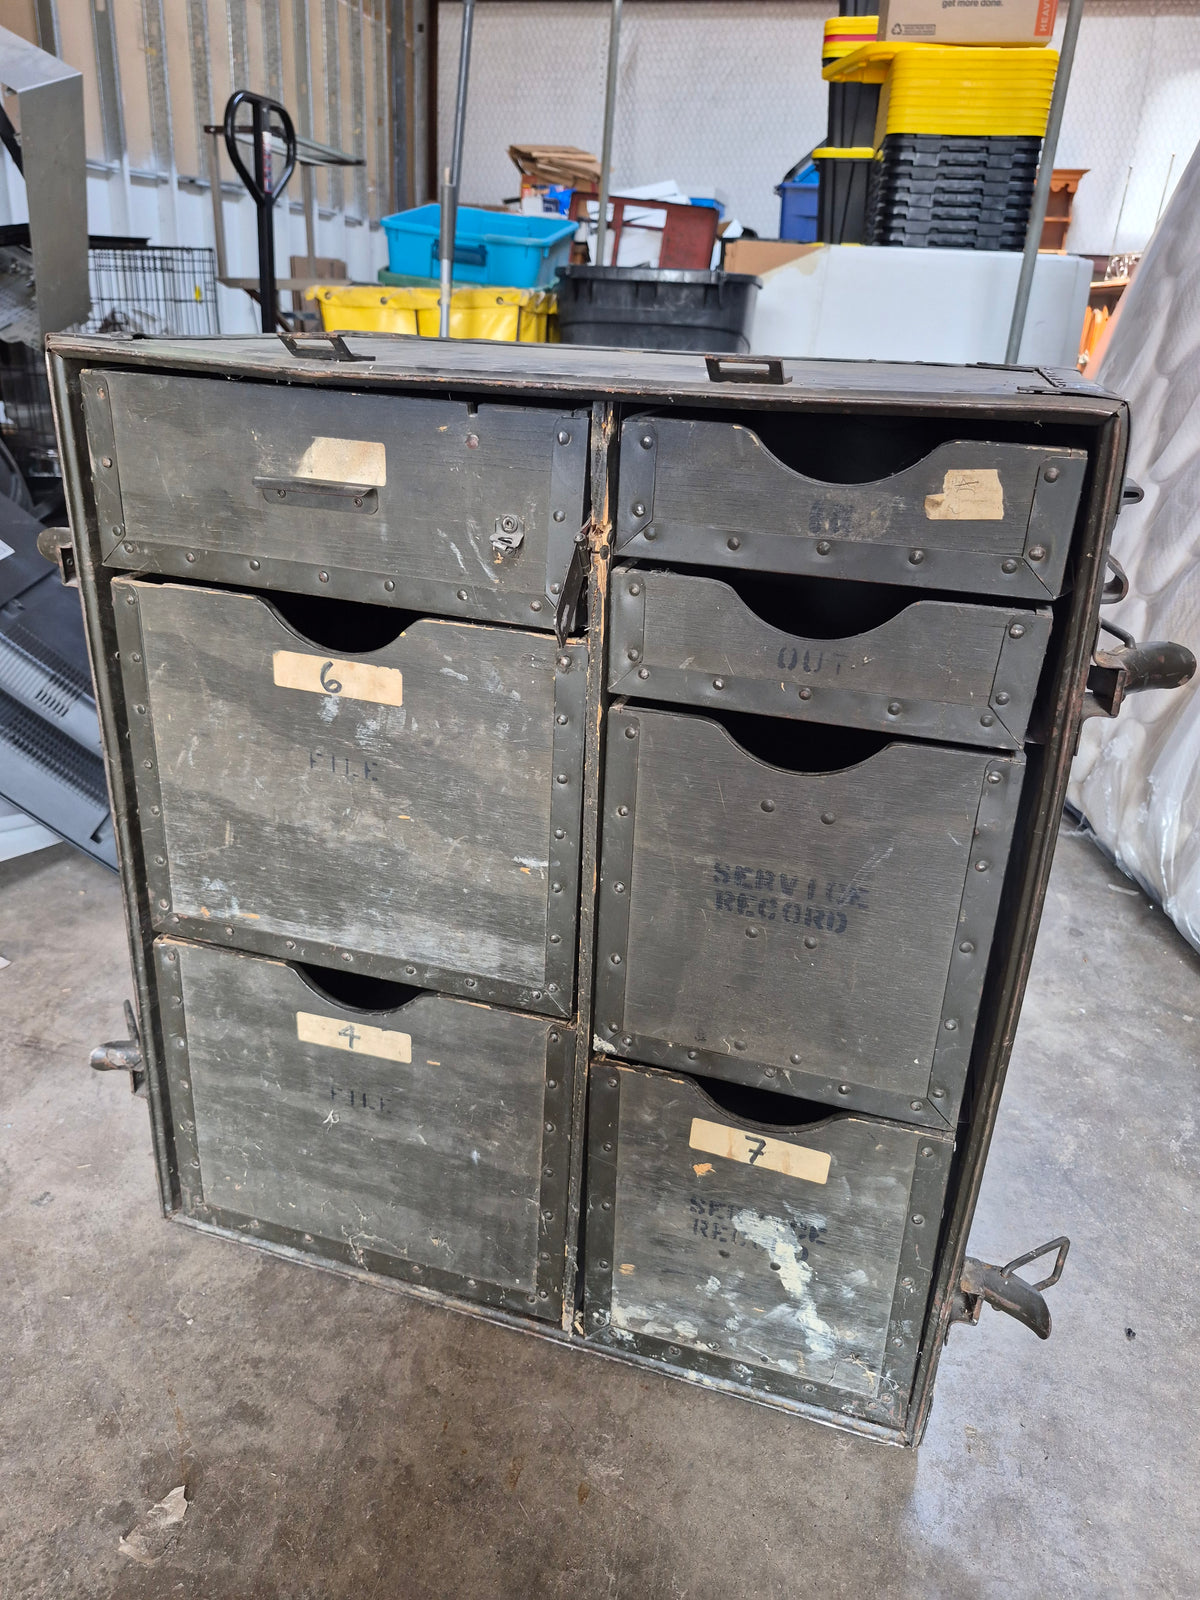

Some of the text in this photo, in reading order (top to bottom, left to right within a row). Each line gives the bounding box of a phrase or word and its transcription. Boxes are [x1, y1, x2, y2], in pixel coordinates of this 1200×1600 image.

[942, 0, 956, 9] get
[957, 0, 979, 8] more
[1039, 0, 1051, 32] HEAV
[777, 647, 848, 675] OUT
[320, 660, 343, 694] 6
[309, 752, 379, 782] FILE
[713, 862, 870, 910] SERVICE
[715, 889, 848, 934] RECORD
[338, 1024, 362, 1050] 4
[744, 1135, 767, 1165] 7
